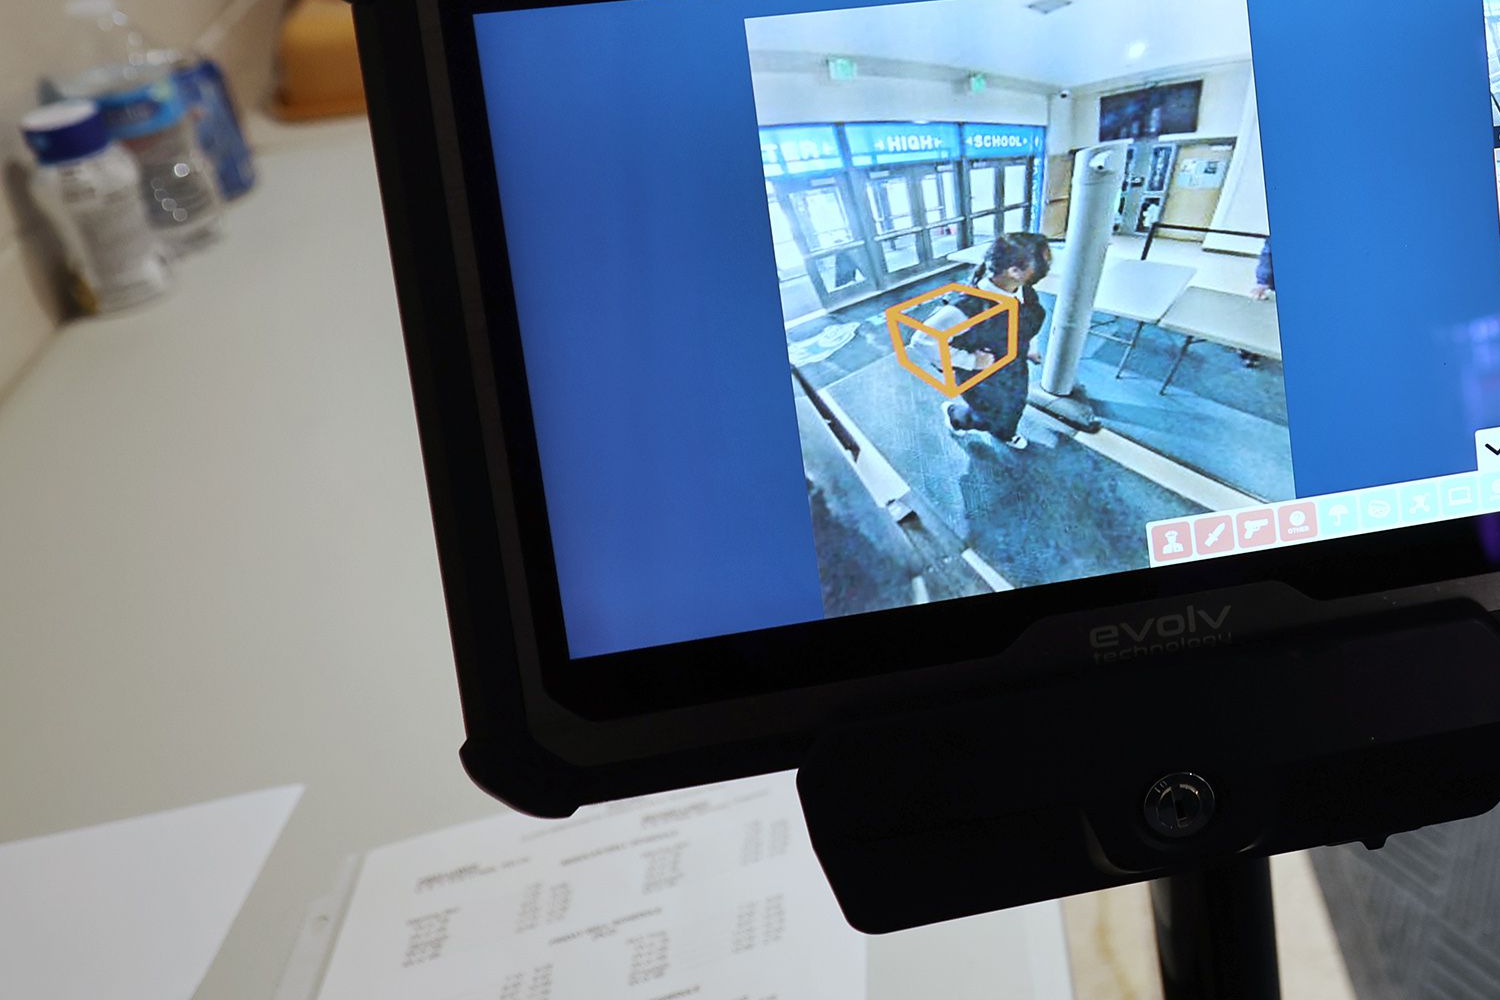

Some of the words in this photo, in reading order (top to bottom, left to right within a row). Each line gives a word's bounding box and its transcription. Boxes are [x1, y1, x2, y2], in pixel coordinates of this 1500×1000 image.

[974, 134, 1022, 148] SCHOOL
[1089, 604, 1232, 648] evolv
[1093, 632, 1232, 664] technolo
